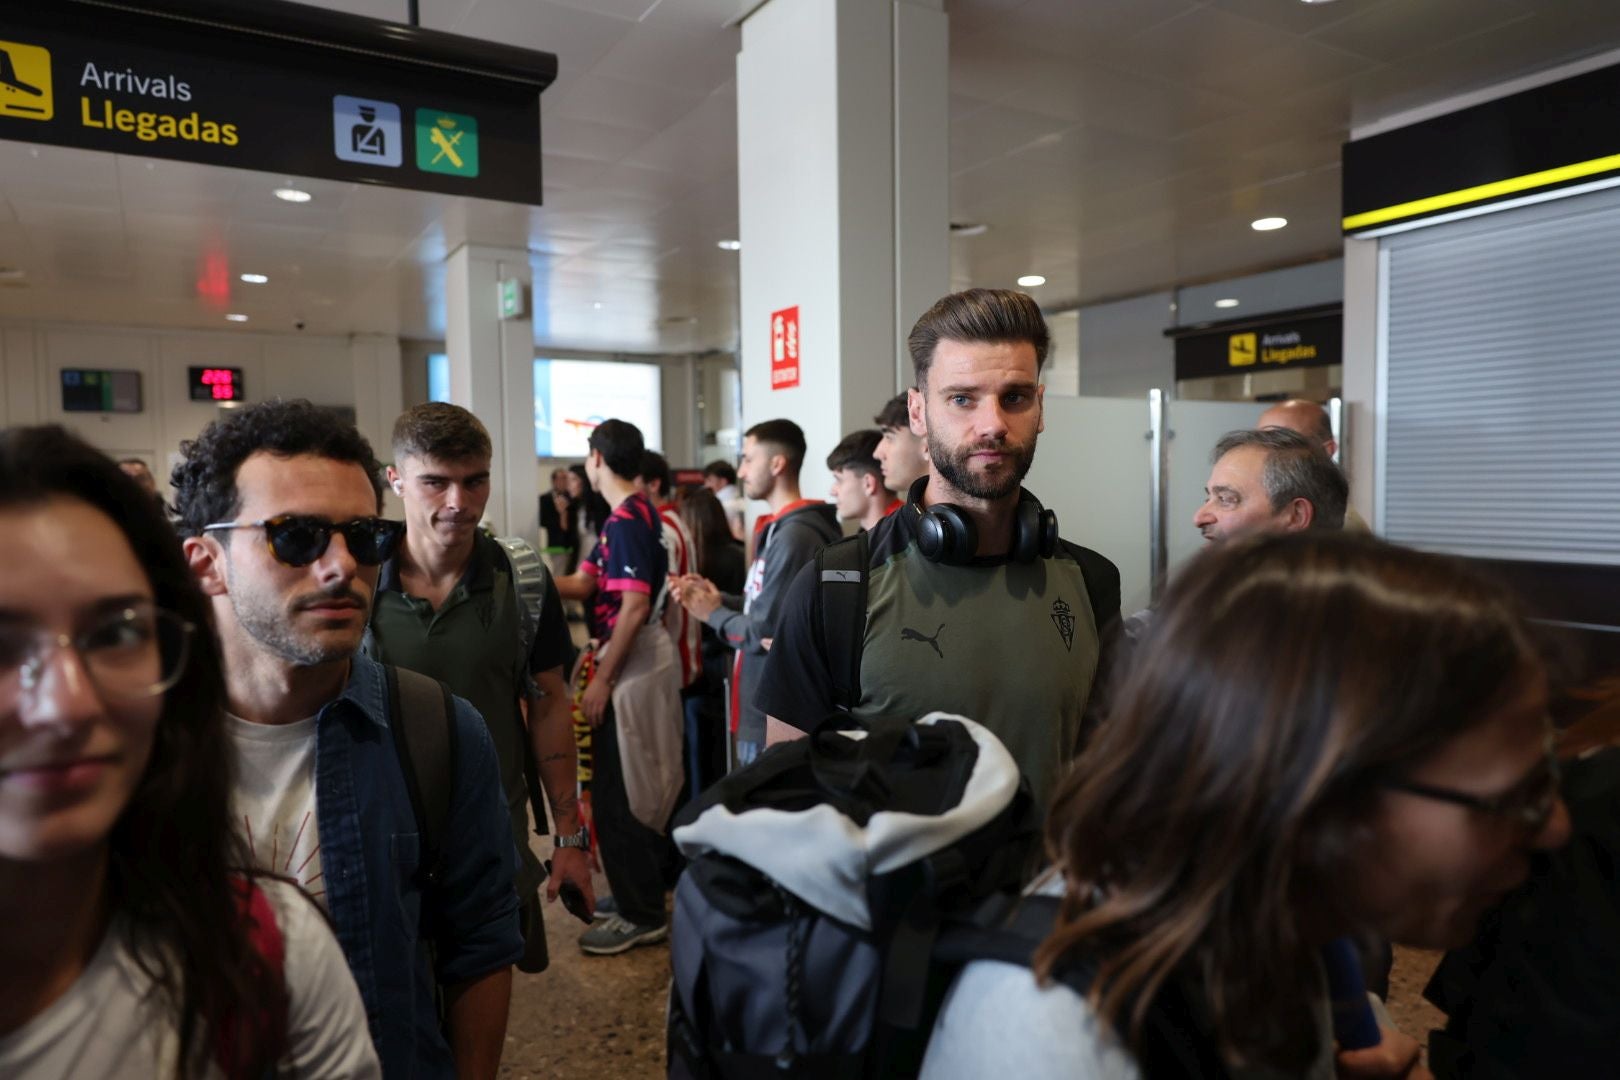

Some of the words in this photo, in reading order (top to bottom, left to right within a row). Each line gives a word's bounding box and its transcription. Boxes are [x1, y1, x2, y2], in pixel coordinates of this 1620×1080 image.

[80, 62, 192, 101] Arrivals
[81, 96, 239, 146] Llegadas
[1263, 332, 1299, 345] Arrivals
[1262, 346, 1316, 363] Llegadas
